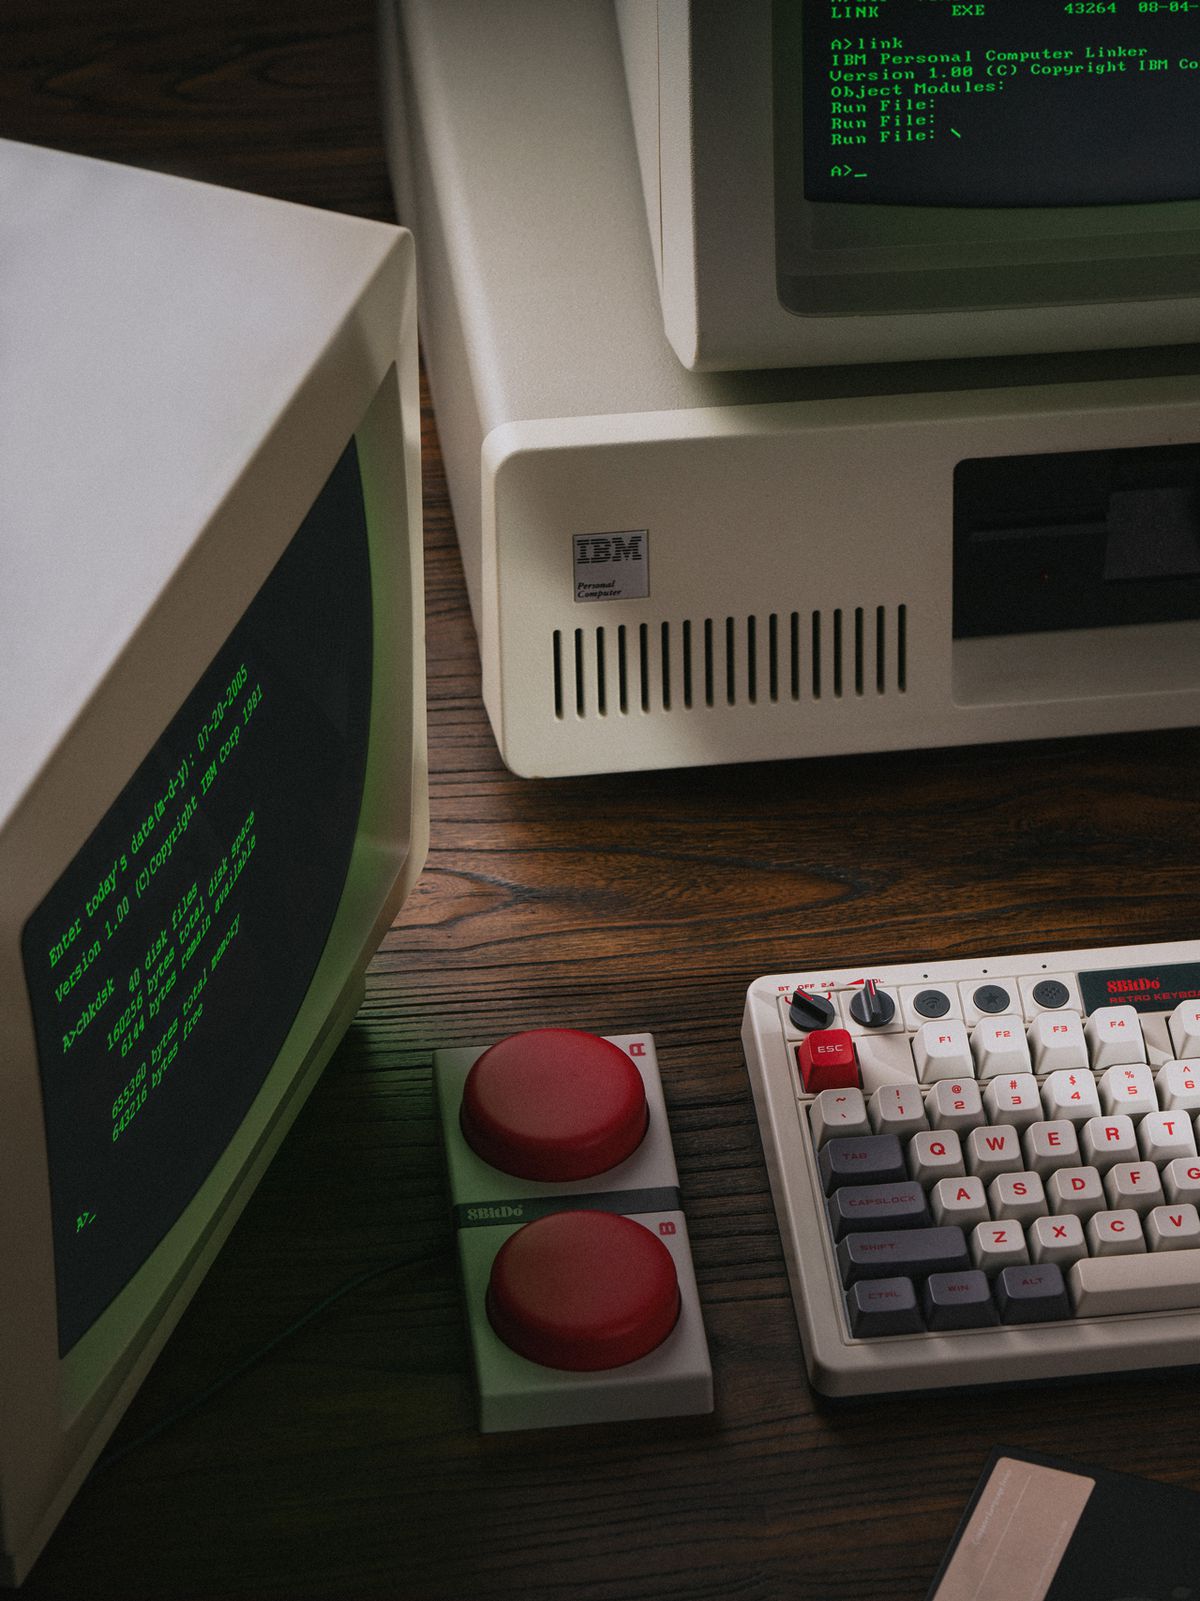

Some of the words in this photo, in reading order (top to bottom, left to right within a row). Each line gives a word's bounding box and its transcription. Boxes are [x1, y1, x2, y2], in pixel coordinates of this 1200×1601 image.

[831, 6, 880, 19] LINK
[951, 4, 984, 17] EXE
[1065, 2, 1116, 14] 43264
[832, 53, 867, 67] IBM
[880, 50, 971, 65] Personal
[985, 49, 1072, 63] Computer
[1085, 47, 1148, 58] Linker
[829, 68, 915, 83] Version
[929, 65, 973, 79] 1.00
[986, 64, 1017, 76] (C)
[1030, 61, 1125, 76] Copyright
[1139, 59, 1169, 71] IBM
[830, 84, 902, 100] Object
[914, 81, 1003, 94] Modules:
[831, 101, 867, 114] Run
[880, 98, 934, 112] File:
[832, 117, 867, 129] Run
[880, 114, 934, 128] File:
[832, 133, 867, 145] Run
[880, 129, 934, 143] File:
[576, 536, 642, 564] IBM
[577, 580, 615, 589] Personal
[577, 590, 622, 598] Computer
[49, 917, 82, 968] Enter
[85, 853, 127, 918] today's
[198, 665, 248, 753] 07-20-2005
[55, 940, 101, 1003] Version
[104, 896, 129, 941] 1.00
[200, 759, 218, 795] IBM
[219, 725, 240, 764] Corp
[243, 685, 263, 725] 1981
[107, 991, 144, 1052] 160256
[146, 946, 175, 996] bytes
[179, 896, 204, 945] total
[208, 858, 228, 897] disk
[231, 811, 255, 859] space
[128, 967, 140, 993] 40
[144, 929, 167, 971] disk
[172, 883, 198, 931] files
[120, 1014, 145, 1057] 6144
[149, 968, 177, 1020] bytes
[181, 914, 211, 971] remain
[214, 835, 256, 915] available
[1107, 978, 1160, 993] 8BitDo
[1110, 993, 1151, 1003] RETRO
[111, 1061, 146, 1120] 655360
[151, 1017, 179, 1066] bytes
[182, 971, 207, 1017] total
[211, 914, 240, 970] memory
[1110, 1020, 1125, 1028] F4
[629, 1043, 646, 1057] A
[816, 1045, 842, 1053] ESC
[112, 1083, 148, 1142] 643216
[151, 1041, 179, 1088] bytes
[183, 1003, 203, 1040] free
[1127, 1086, 1137, 1095] 5
[954, 1100, 964, 1109] 2
[1013, 1096, 1022, 1104] 3
[898, 1106, 905, 1115] 1
[1105, 1127, 1119, 1141] R
[1163, 1122, 1174, 1136] T
[986, 1137, 1005, 1150] W
[1048, 1131, 1060, 1146] E
[930, 1142, 945, 1155] Q
[1130, 1171, 1139, 1184] F
[1188, 1168, 1200, 1180] G
[1013, 1183, 1027, 1195] S
[1072, 1178, 1085, 1192] D
[957, 1188, 970, 1200] A
[466, 1205, 523, 1221] 8BitDo
[1110, 1220, 1125, 1232] C
[1170, 1216, 1182, 1227] V
[660, 1222, 675, 1235] B
[1054, 1226, 1066, 1238] X
[993, 1231, 1006, 1243] Z
[860, 1243, 896, 1252] SHIFT
[1021, 1278, 1043, 1286] ALT
